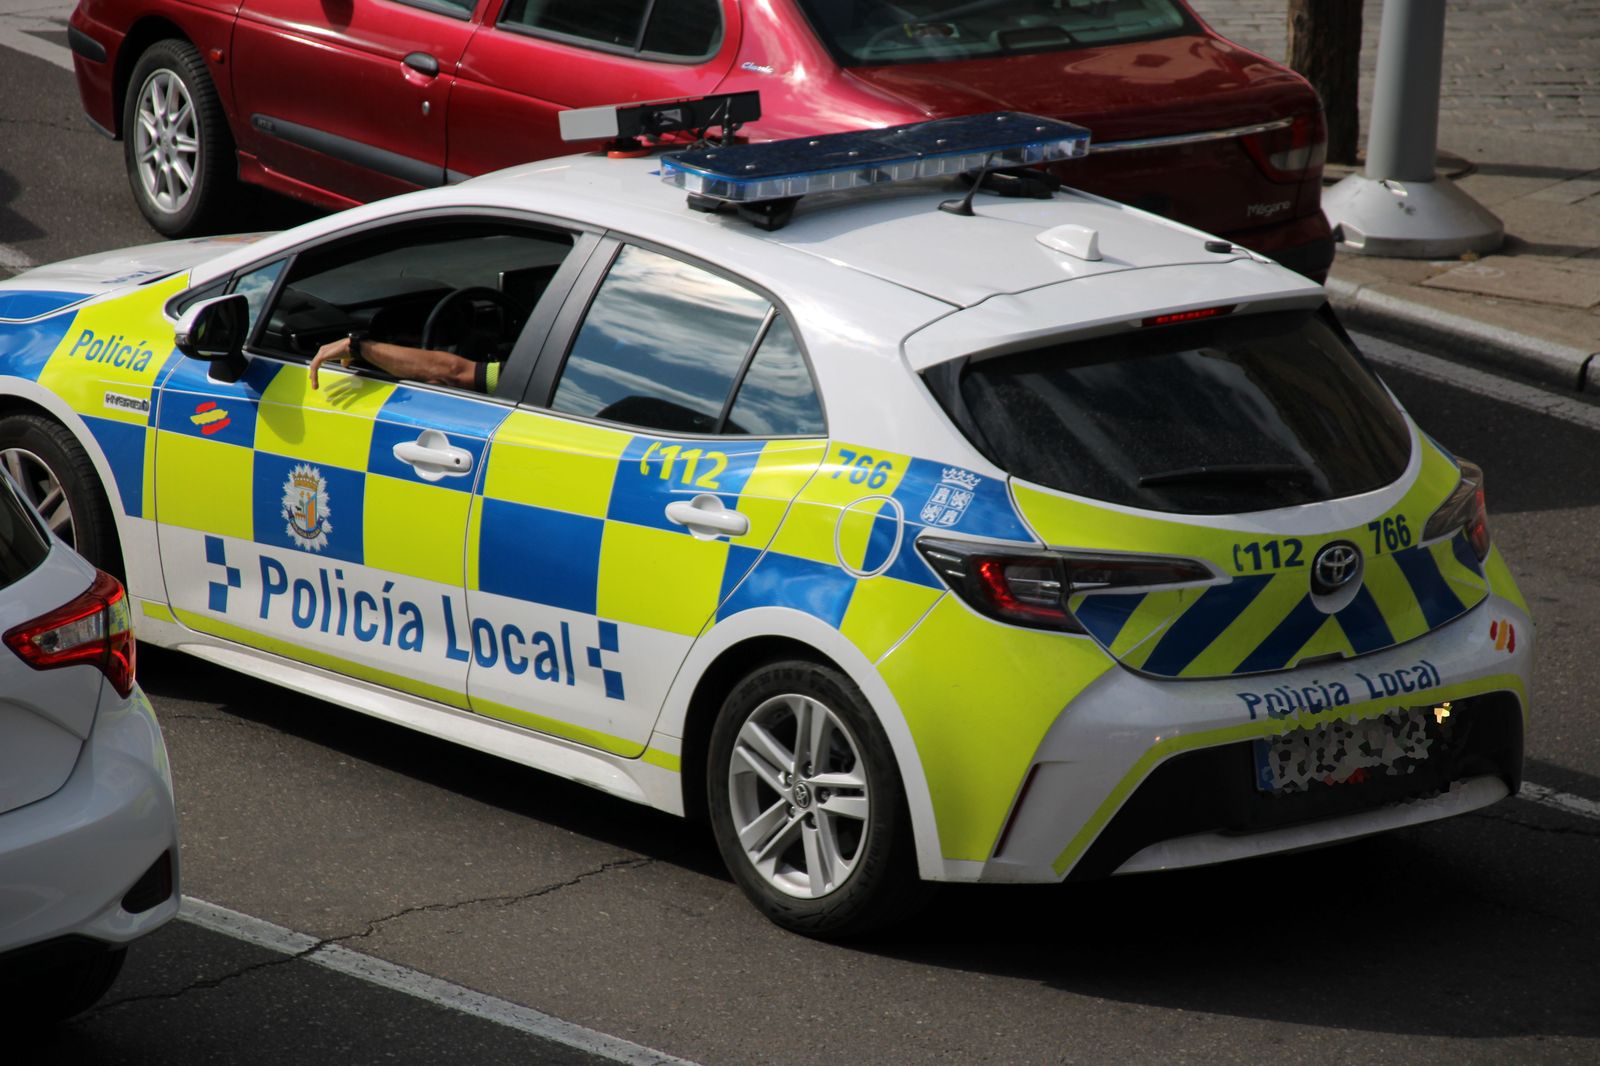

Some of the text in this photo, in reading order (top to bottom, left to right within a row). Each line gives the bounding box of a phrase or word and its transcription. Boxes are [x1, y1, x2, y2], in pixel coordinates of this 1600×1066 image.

[69, 329, 153, 372] Policía
[659, 445, 729, 489] 112
[831, 449, 893, 489] 766
[1243, 538, 1304, 571] 112
[1368, 514, 1411, 555] 766
[259, 555, 575, 686] Policía Local
[1355, 660, 1441, 700] Local
